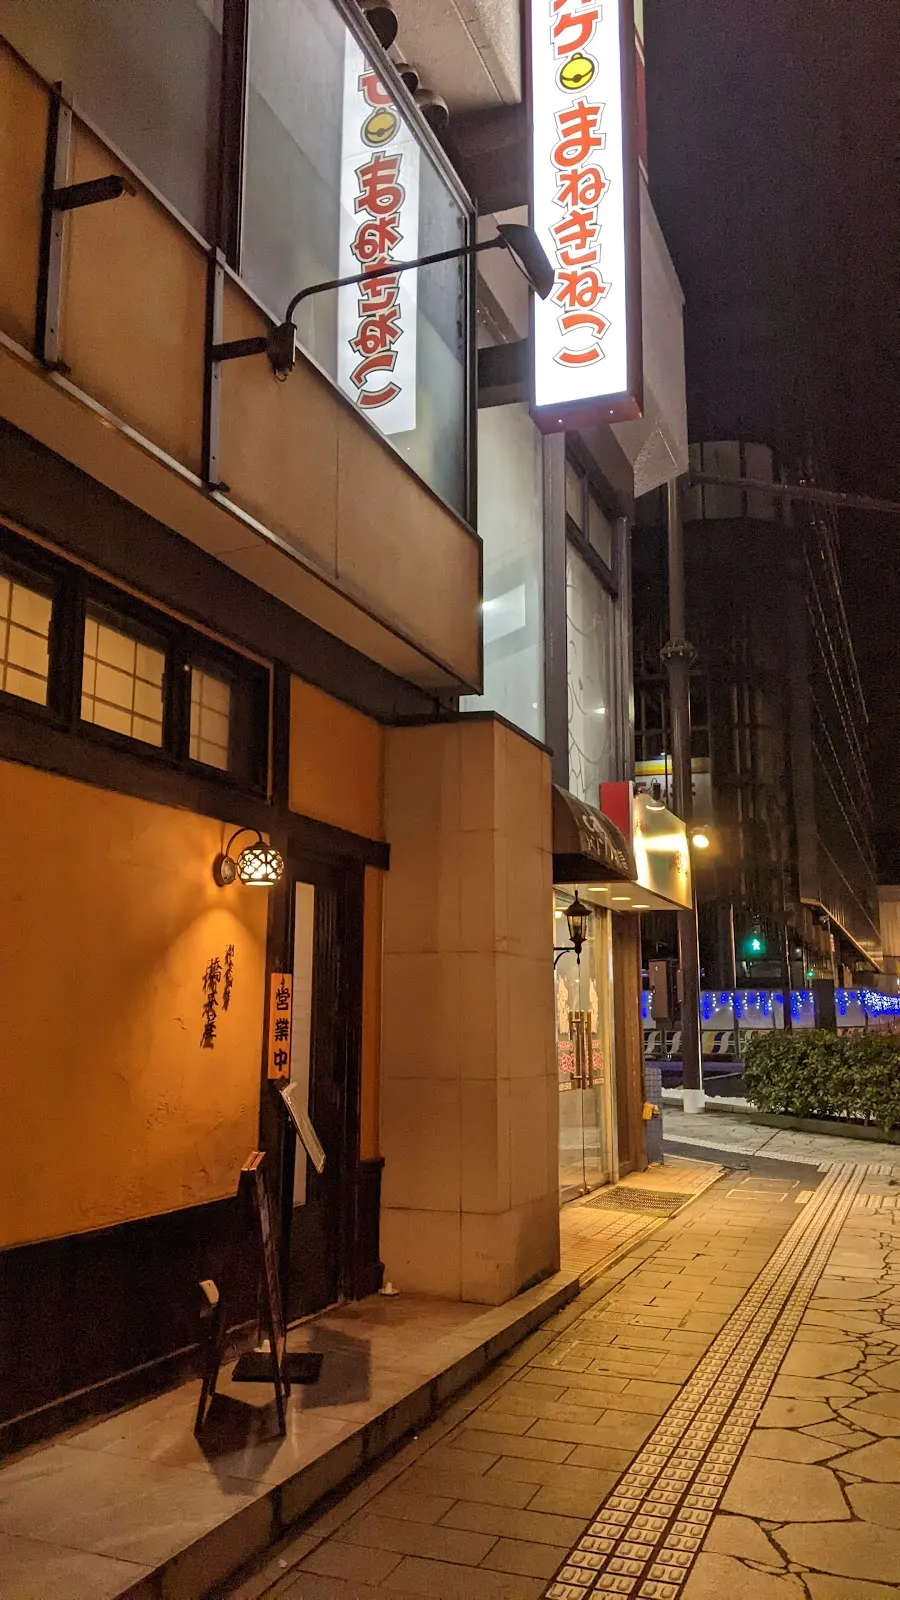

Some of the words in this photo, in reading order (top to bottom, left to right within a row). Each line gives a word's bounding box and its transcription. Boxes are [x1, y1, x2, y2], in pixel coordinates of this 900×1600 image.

[552, 0, 601, 57] ケ
[552, 99, 609, 366] まねきねこ
[273, 987, 290, 1071] 営業中
